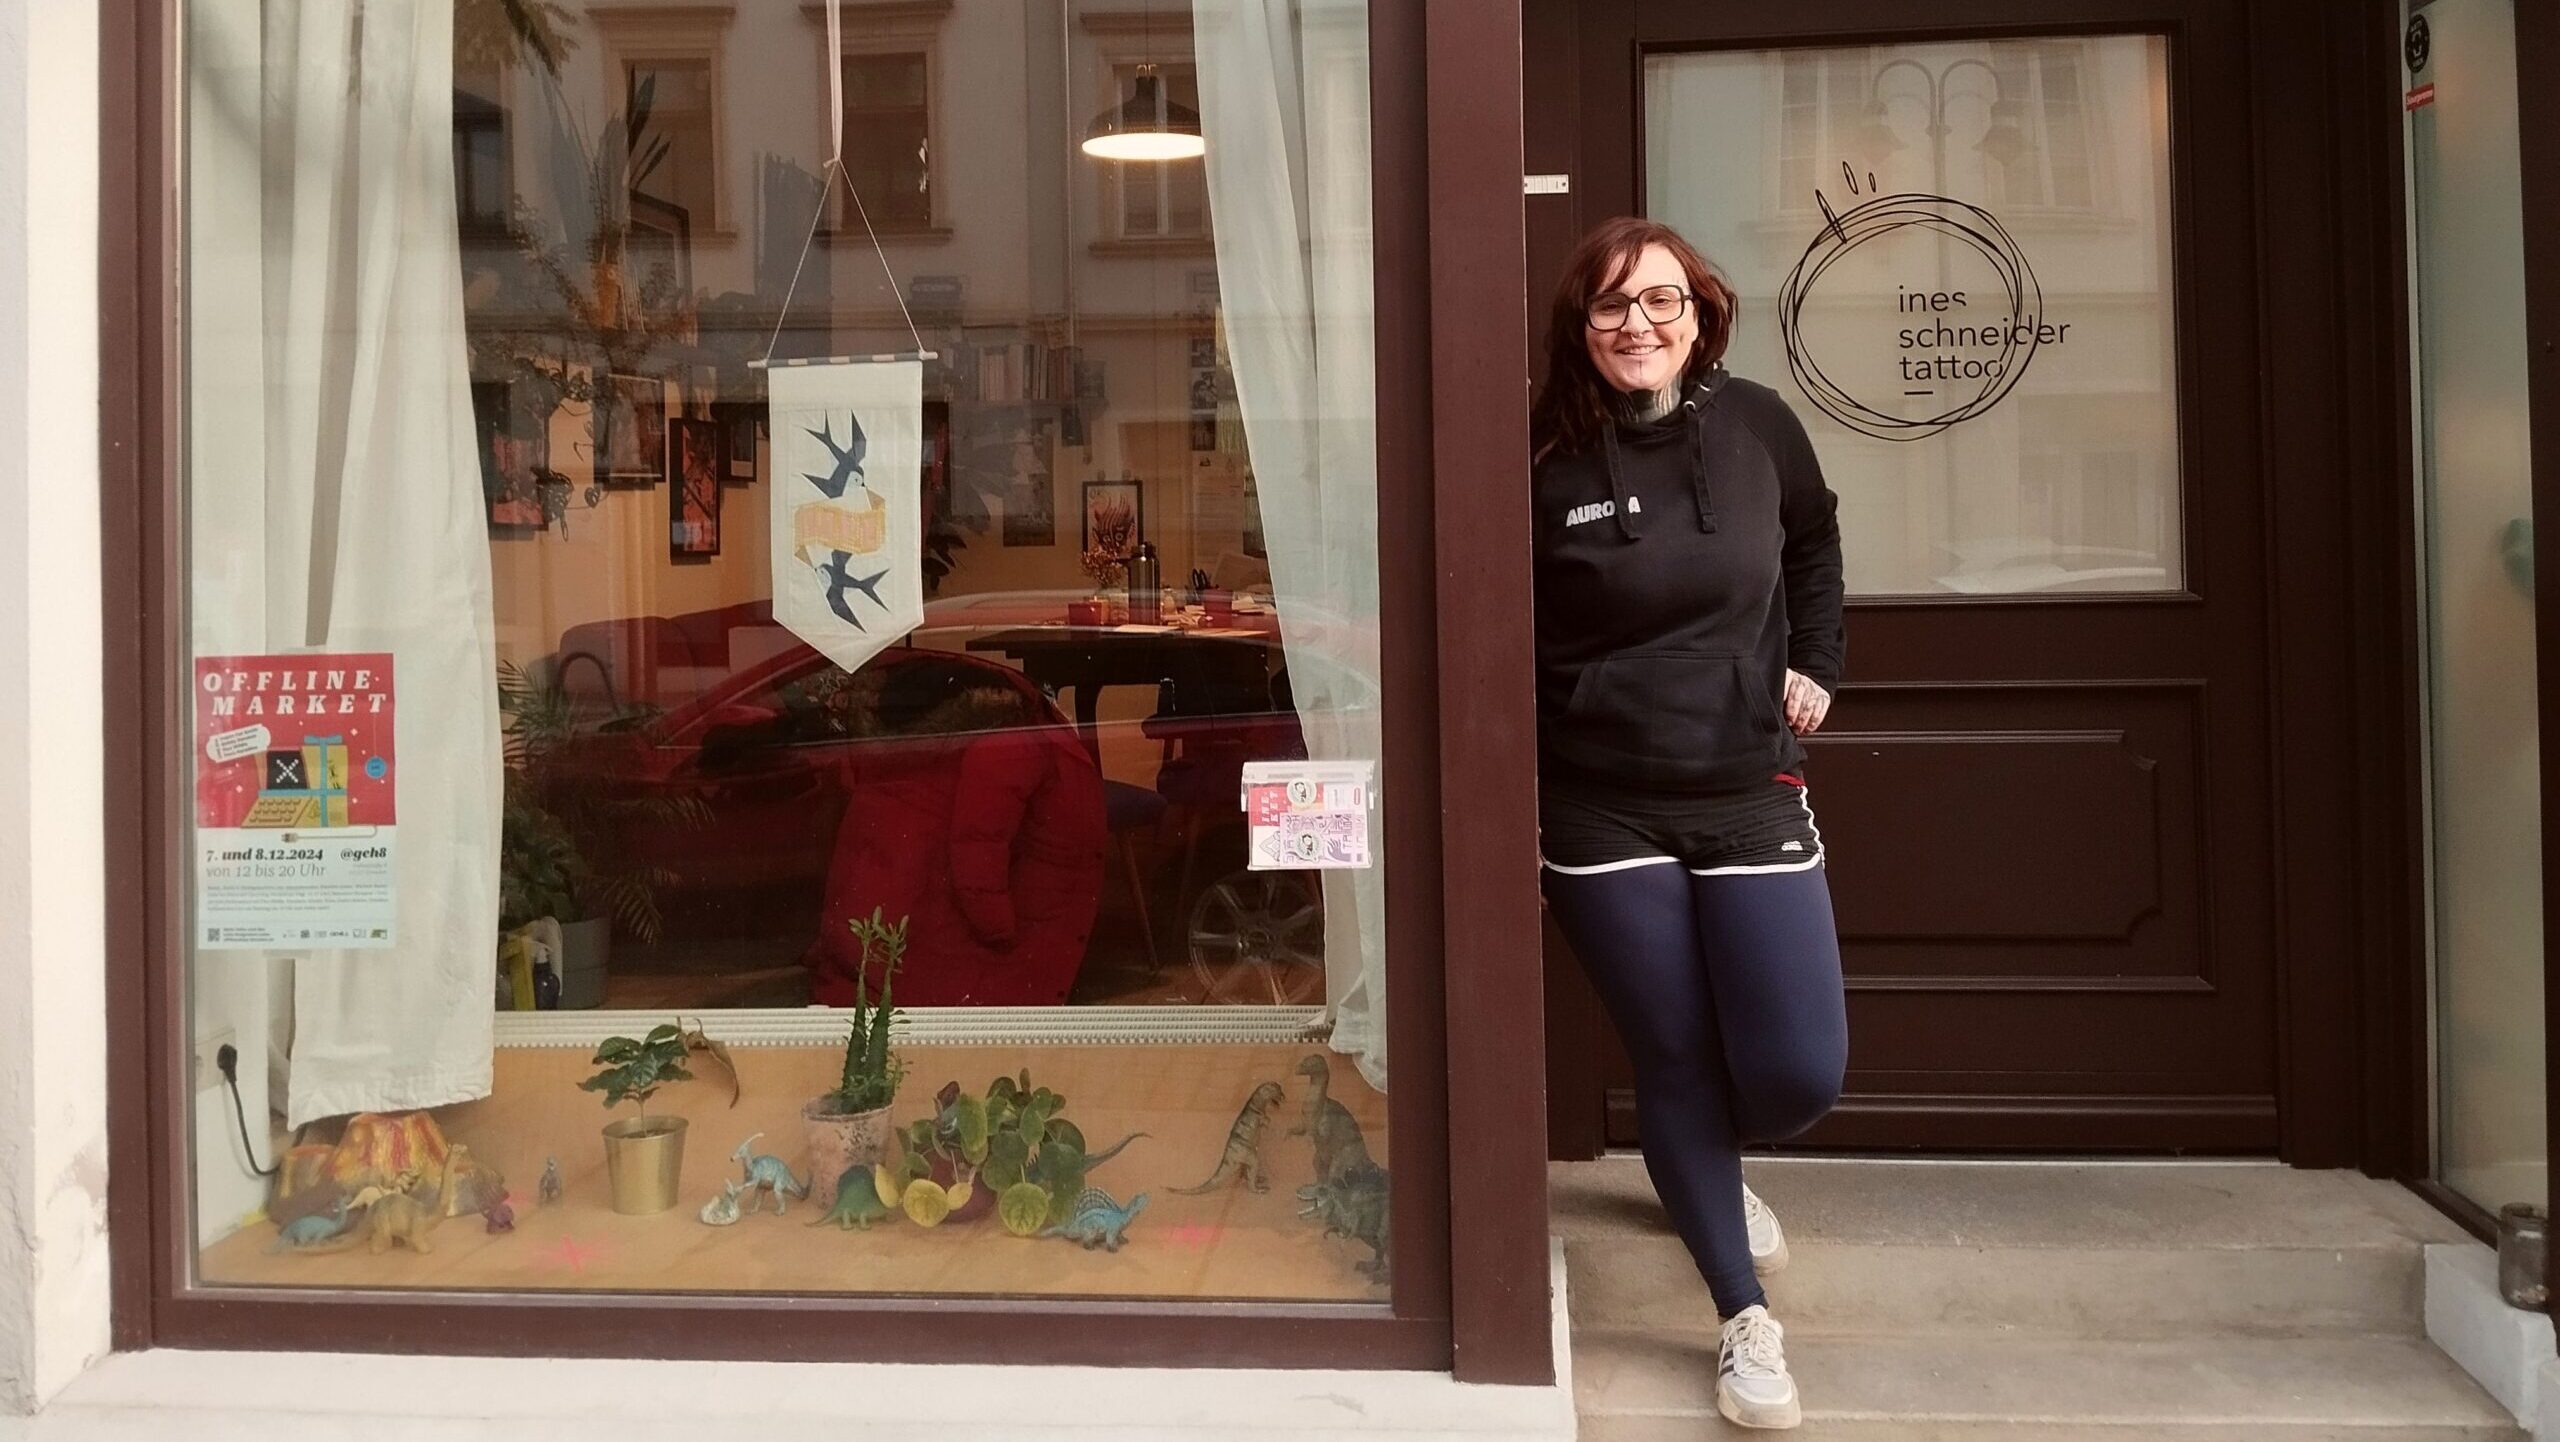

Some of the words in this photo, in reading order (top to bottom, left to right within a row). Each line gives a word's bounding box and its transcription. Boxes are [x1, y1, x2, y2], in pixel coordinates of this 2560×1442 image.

[1898, 284, 1968, 313] ines
[1898, 314, 2072, 349] schneider
[1898, 354, 2004, 381] tattoo
[1565, 496, 1642, 528] AUROA
[203, 669, 371, 692] OFFLINE
[211, 693, 387, 716] MARKET
[206, 849, 219, 863] 7.
[222, 847, 253, 861] und
[255, 847, 324, 862] 8.12.2024
[340, 846, 388, 862] @gch8
[206, 866, 231, 878] von
[235, 865, 252, 878] 12
[255, 863, 276, 878] bis
[278, 864, 296, 878] 20
[299, 862, 327, 878] Uhr
